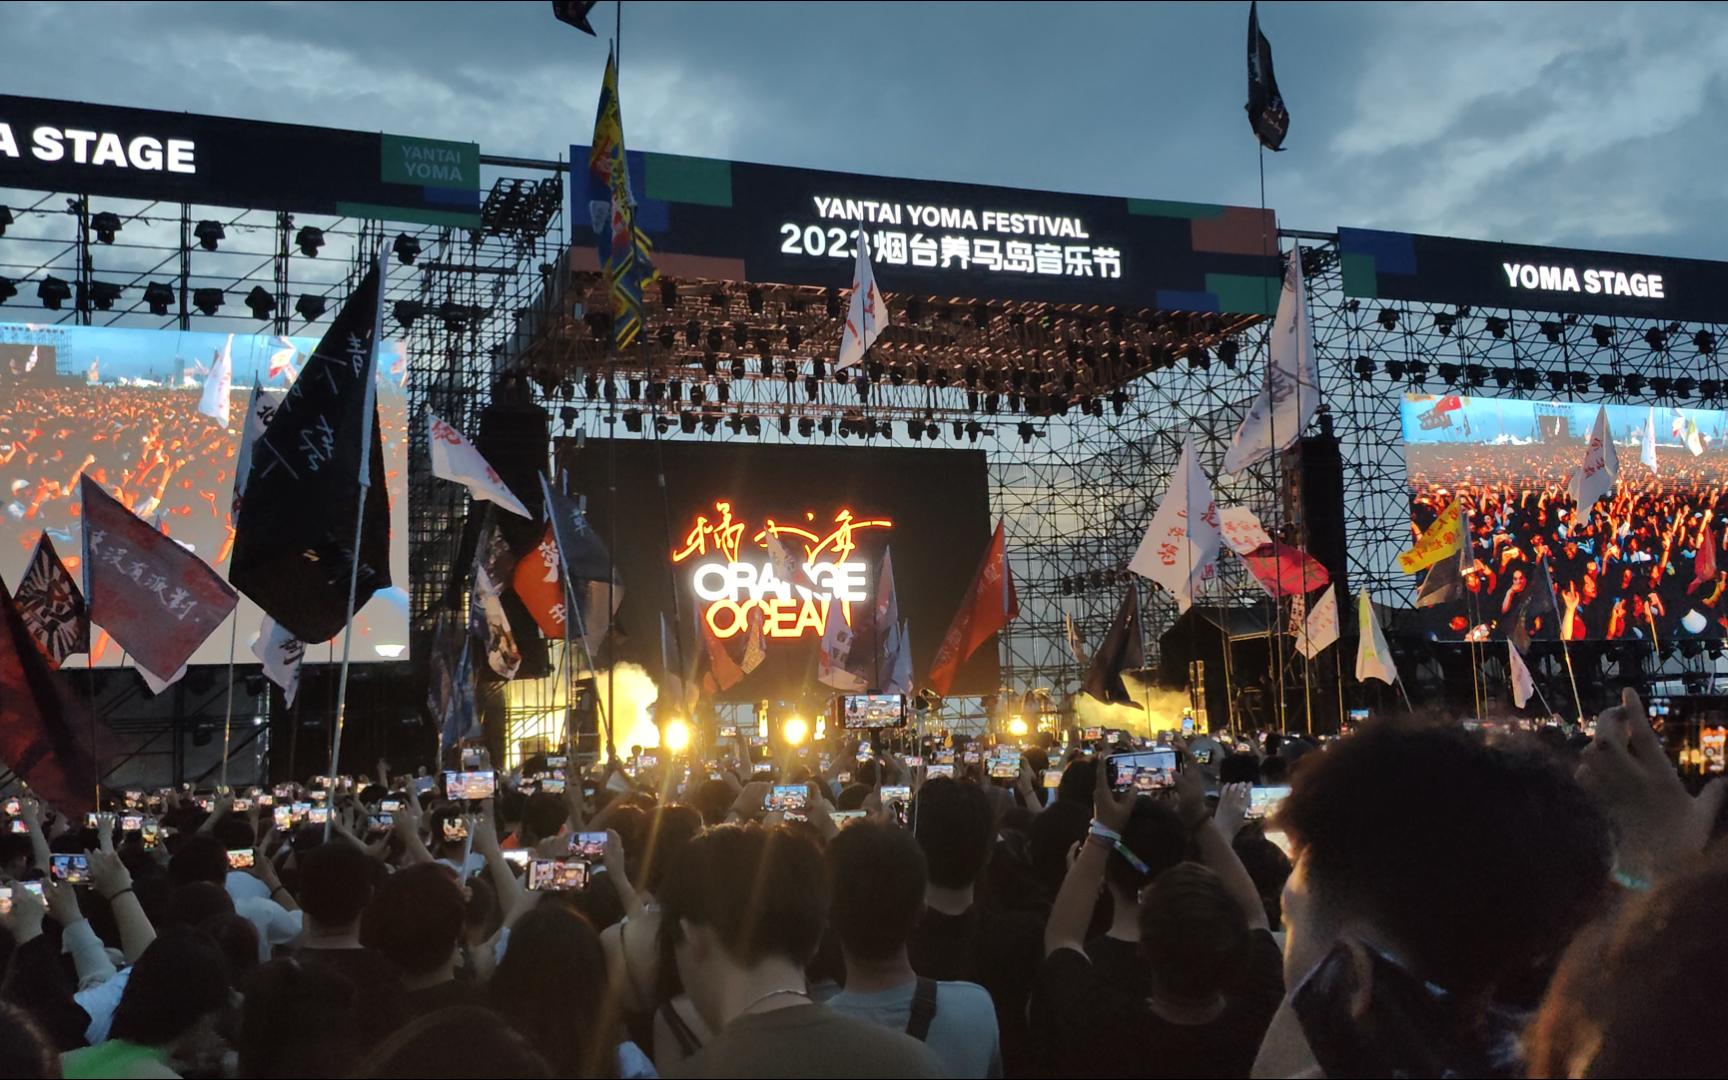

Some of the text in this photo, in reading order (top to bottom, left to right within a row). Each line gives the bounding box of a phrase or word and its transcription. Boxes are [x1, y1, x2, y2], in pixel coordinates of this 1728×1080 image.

[31, 125, 196, 174] STAGE
[402, 145, 461, 164] YANTAI
[404, 162, 463, 182] YOMA
[813, 196, 1090, 239] YANTAI YOMA FESTIVAL
[1502, 262, 1665, 299] YOMA STAGE
